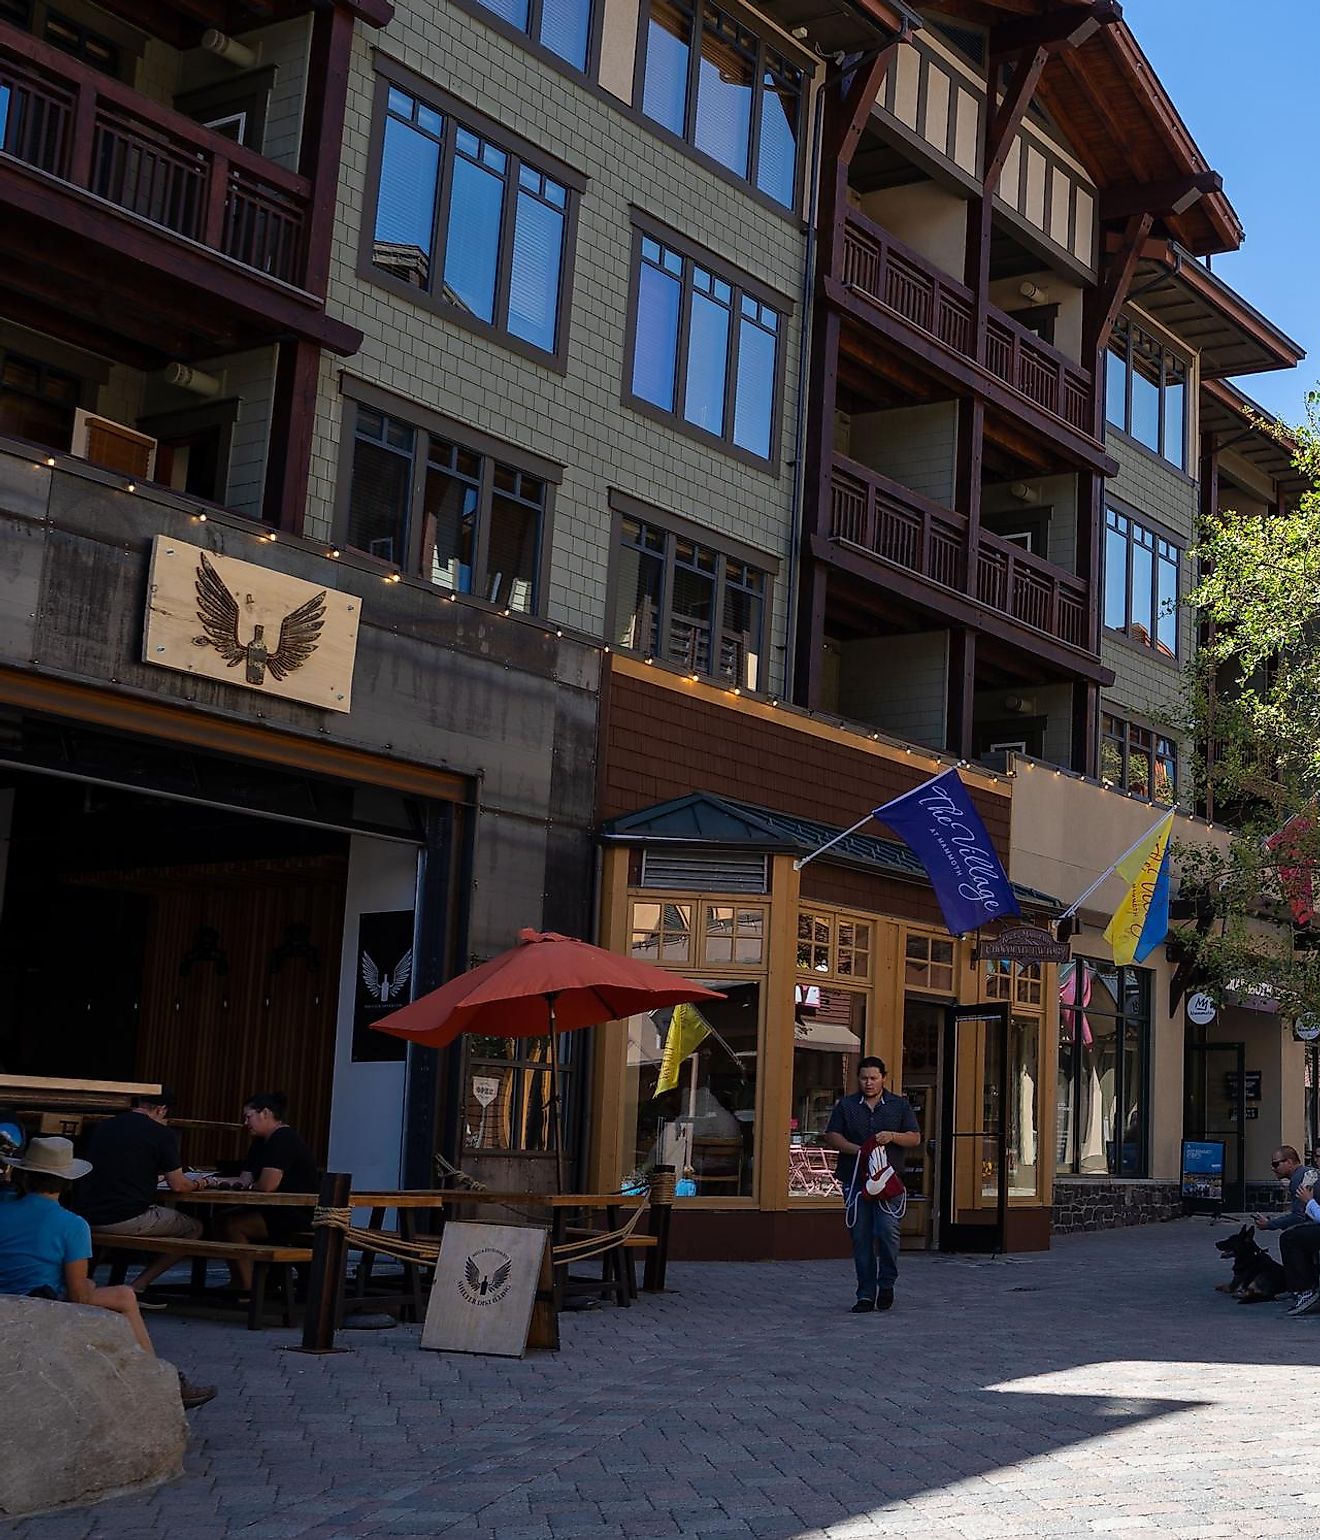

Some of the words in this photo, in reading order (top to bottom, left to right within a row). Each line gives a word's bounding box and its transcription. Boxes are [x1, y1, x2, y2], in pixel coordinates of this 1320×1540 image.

[919, 785, 963, 827] The
[950, 822, 1000, 912] Village
[929, 828, 939, 839] AT
[937, 837, 963, 877] MAMMOTH
